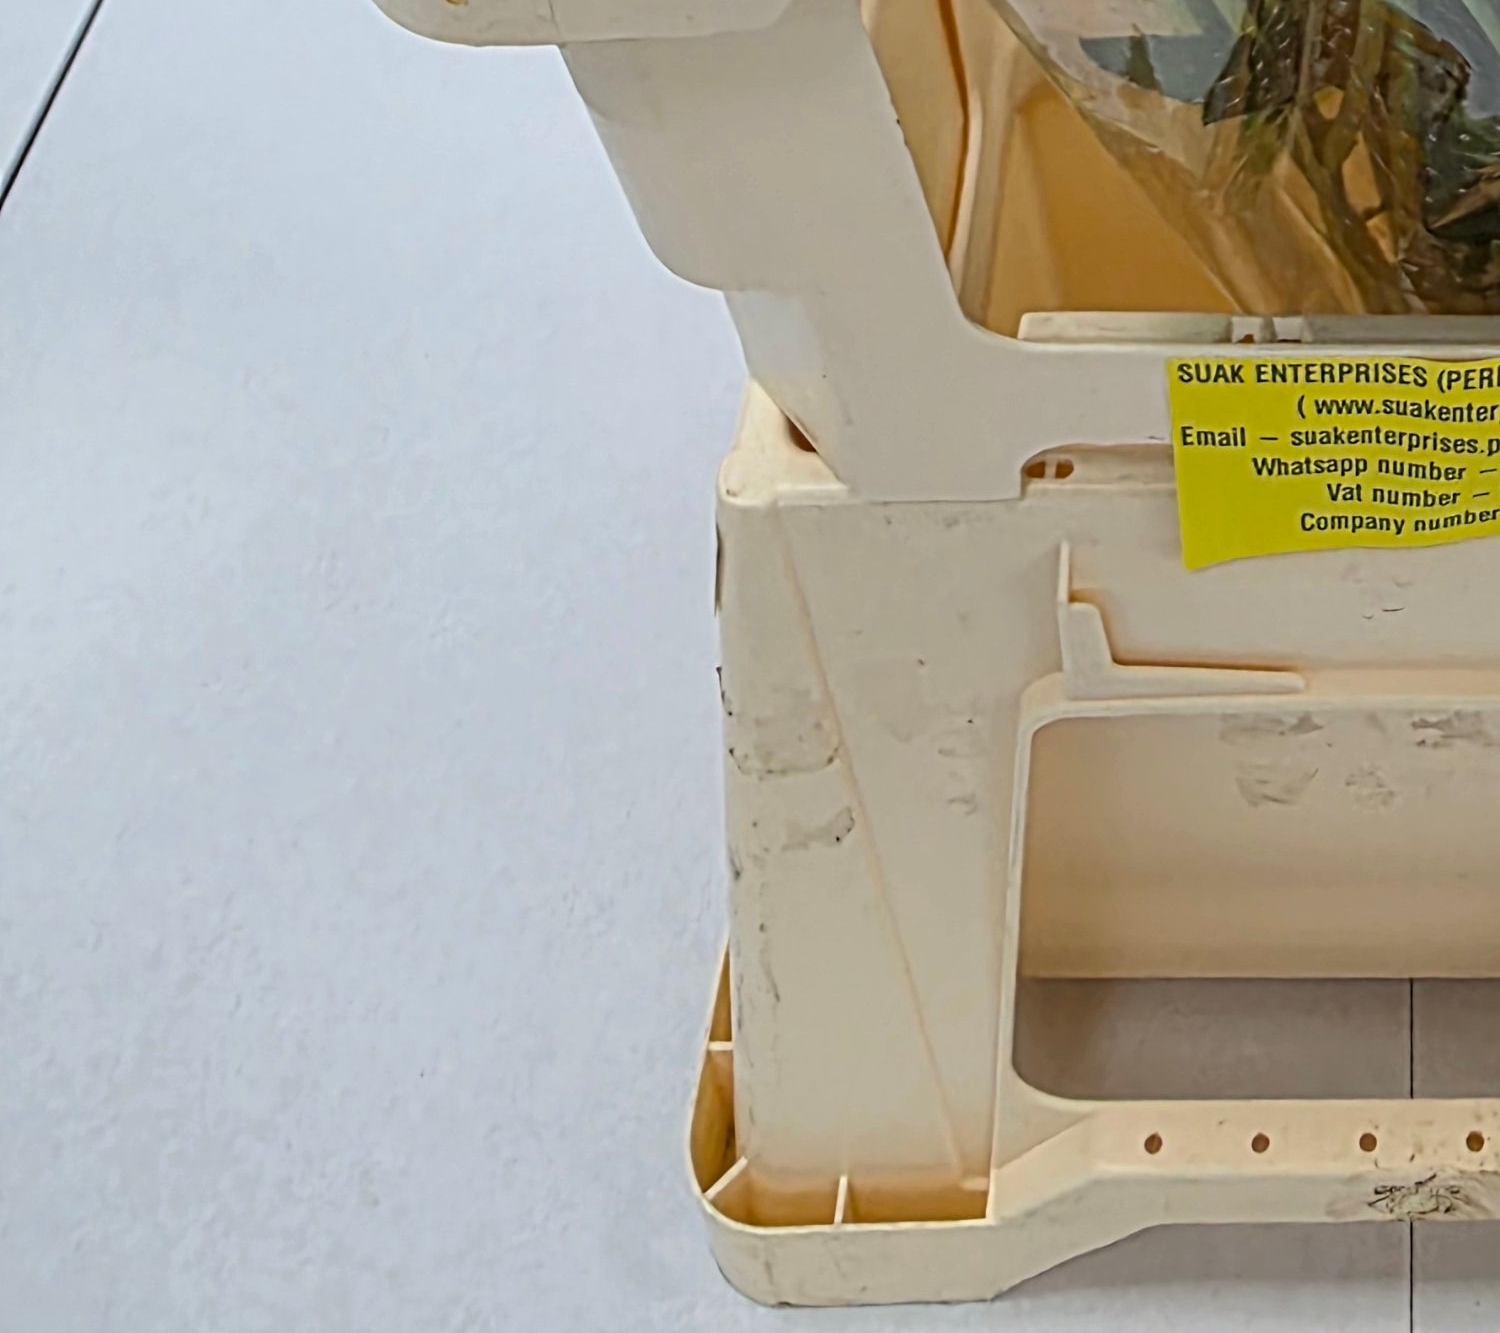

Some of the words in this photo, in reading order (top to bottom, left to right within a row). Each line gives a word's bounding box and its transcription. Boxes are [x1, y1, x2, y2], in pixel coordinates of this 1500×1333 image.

[1177, 363, 1245, 384] SUAK
[1256, 363, 1428, 388] ENTERPRISES
[1297, 395, 1306, 419] (
[1181, 426, 1246, 447] Email
[1252, 456, 1368, 477] Whatsapp
[1377, 459, 1467, 481] number
[1327, 483, 1363, 503] Vat
[1372, 486, 1461, 508] number
[1300, 512, 1405, 535] Company
[1413, 507, 1500, 533] number
